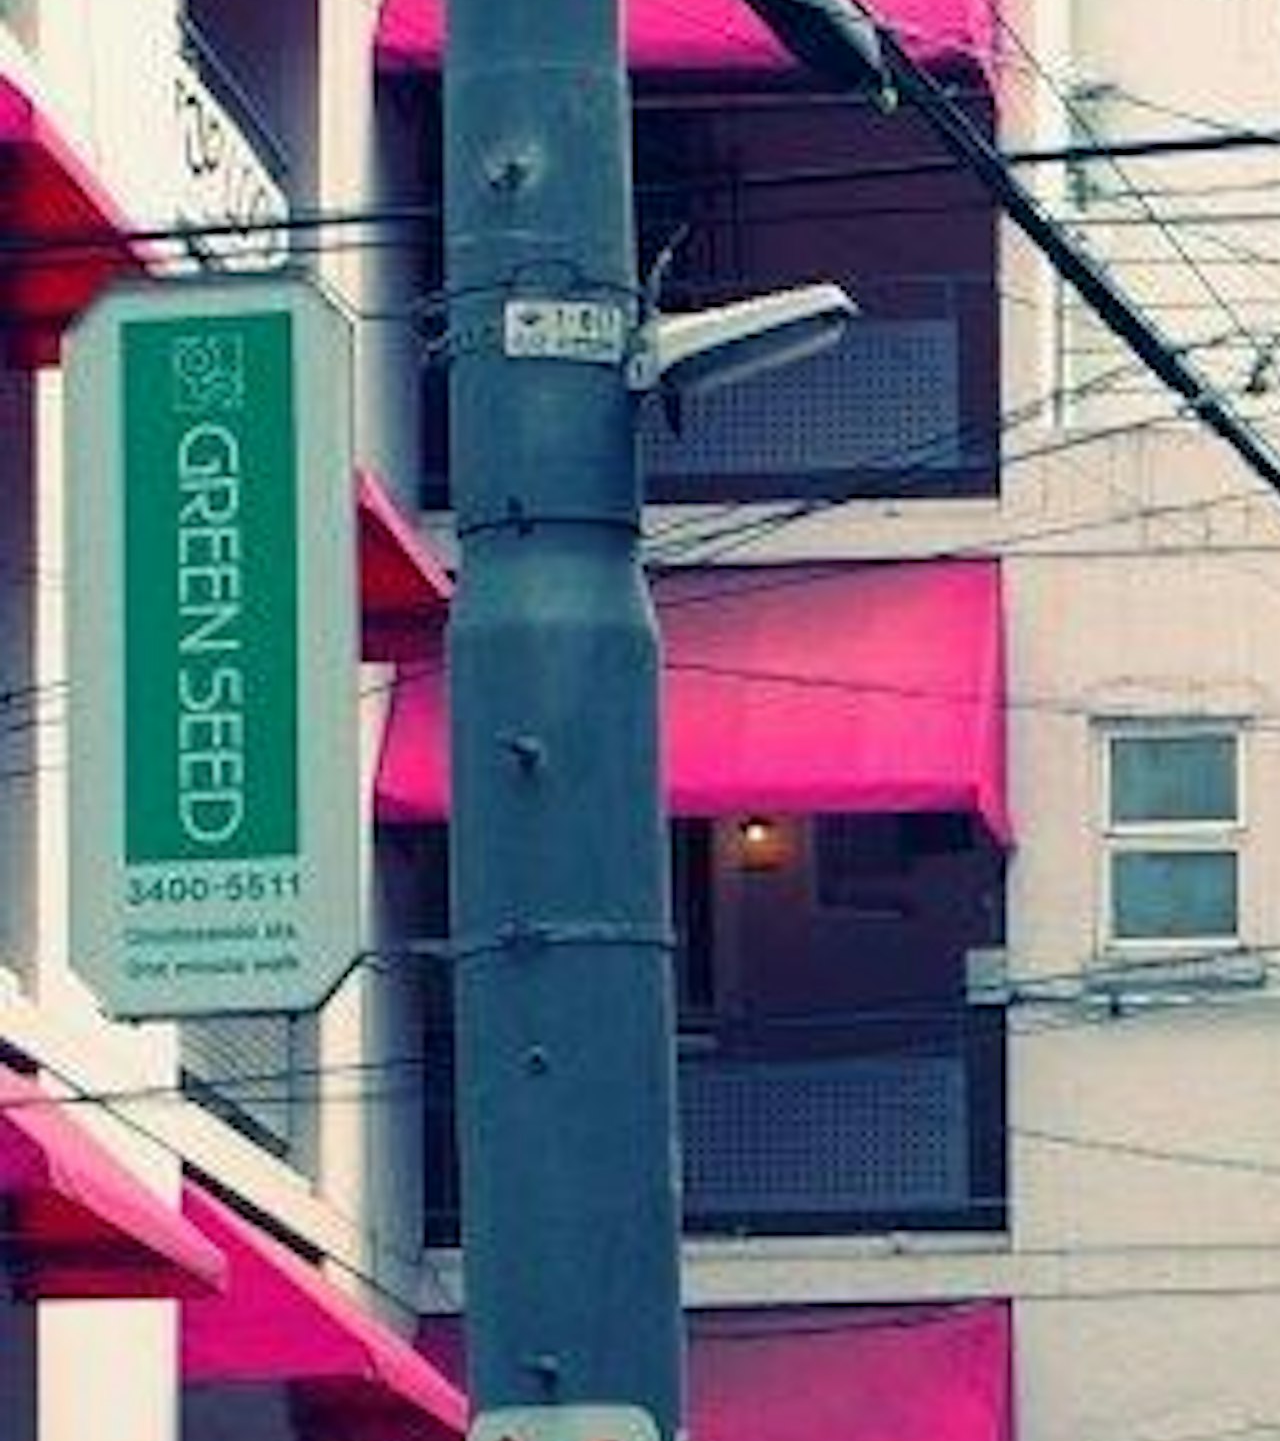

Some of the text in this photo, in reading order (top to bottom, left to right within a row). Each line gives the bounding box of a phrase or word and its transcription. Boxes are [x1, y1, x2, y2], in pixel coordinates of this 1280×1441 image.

[177, 424, 243, 842] GREEN SEED
[127, 874, 300, 905] 3400-5511
